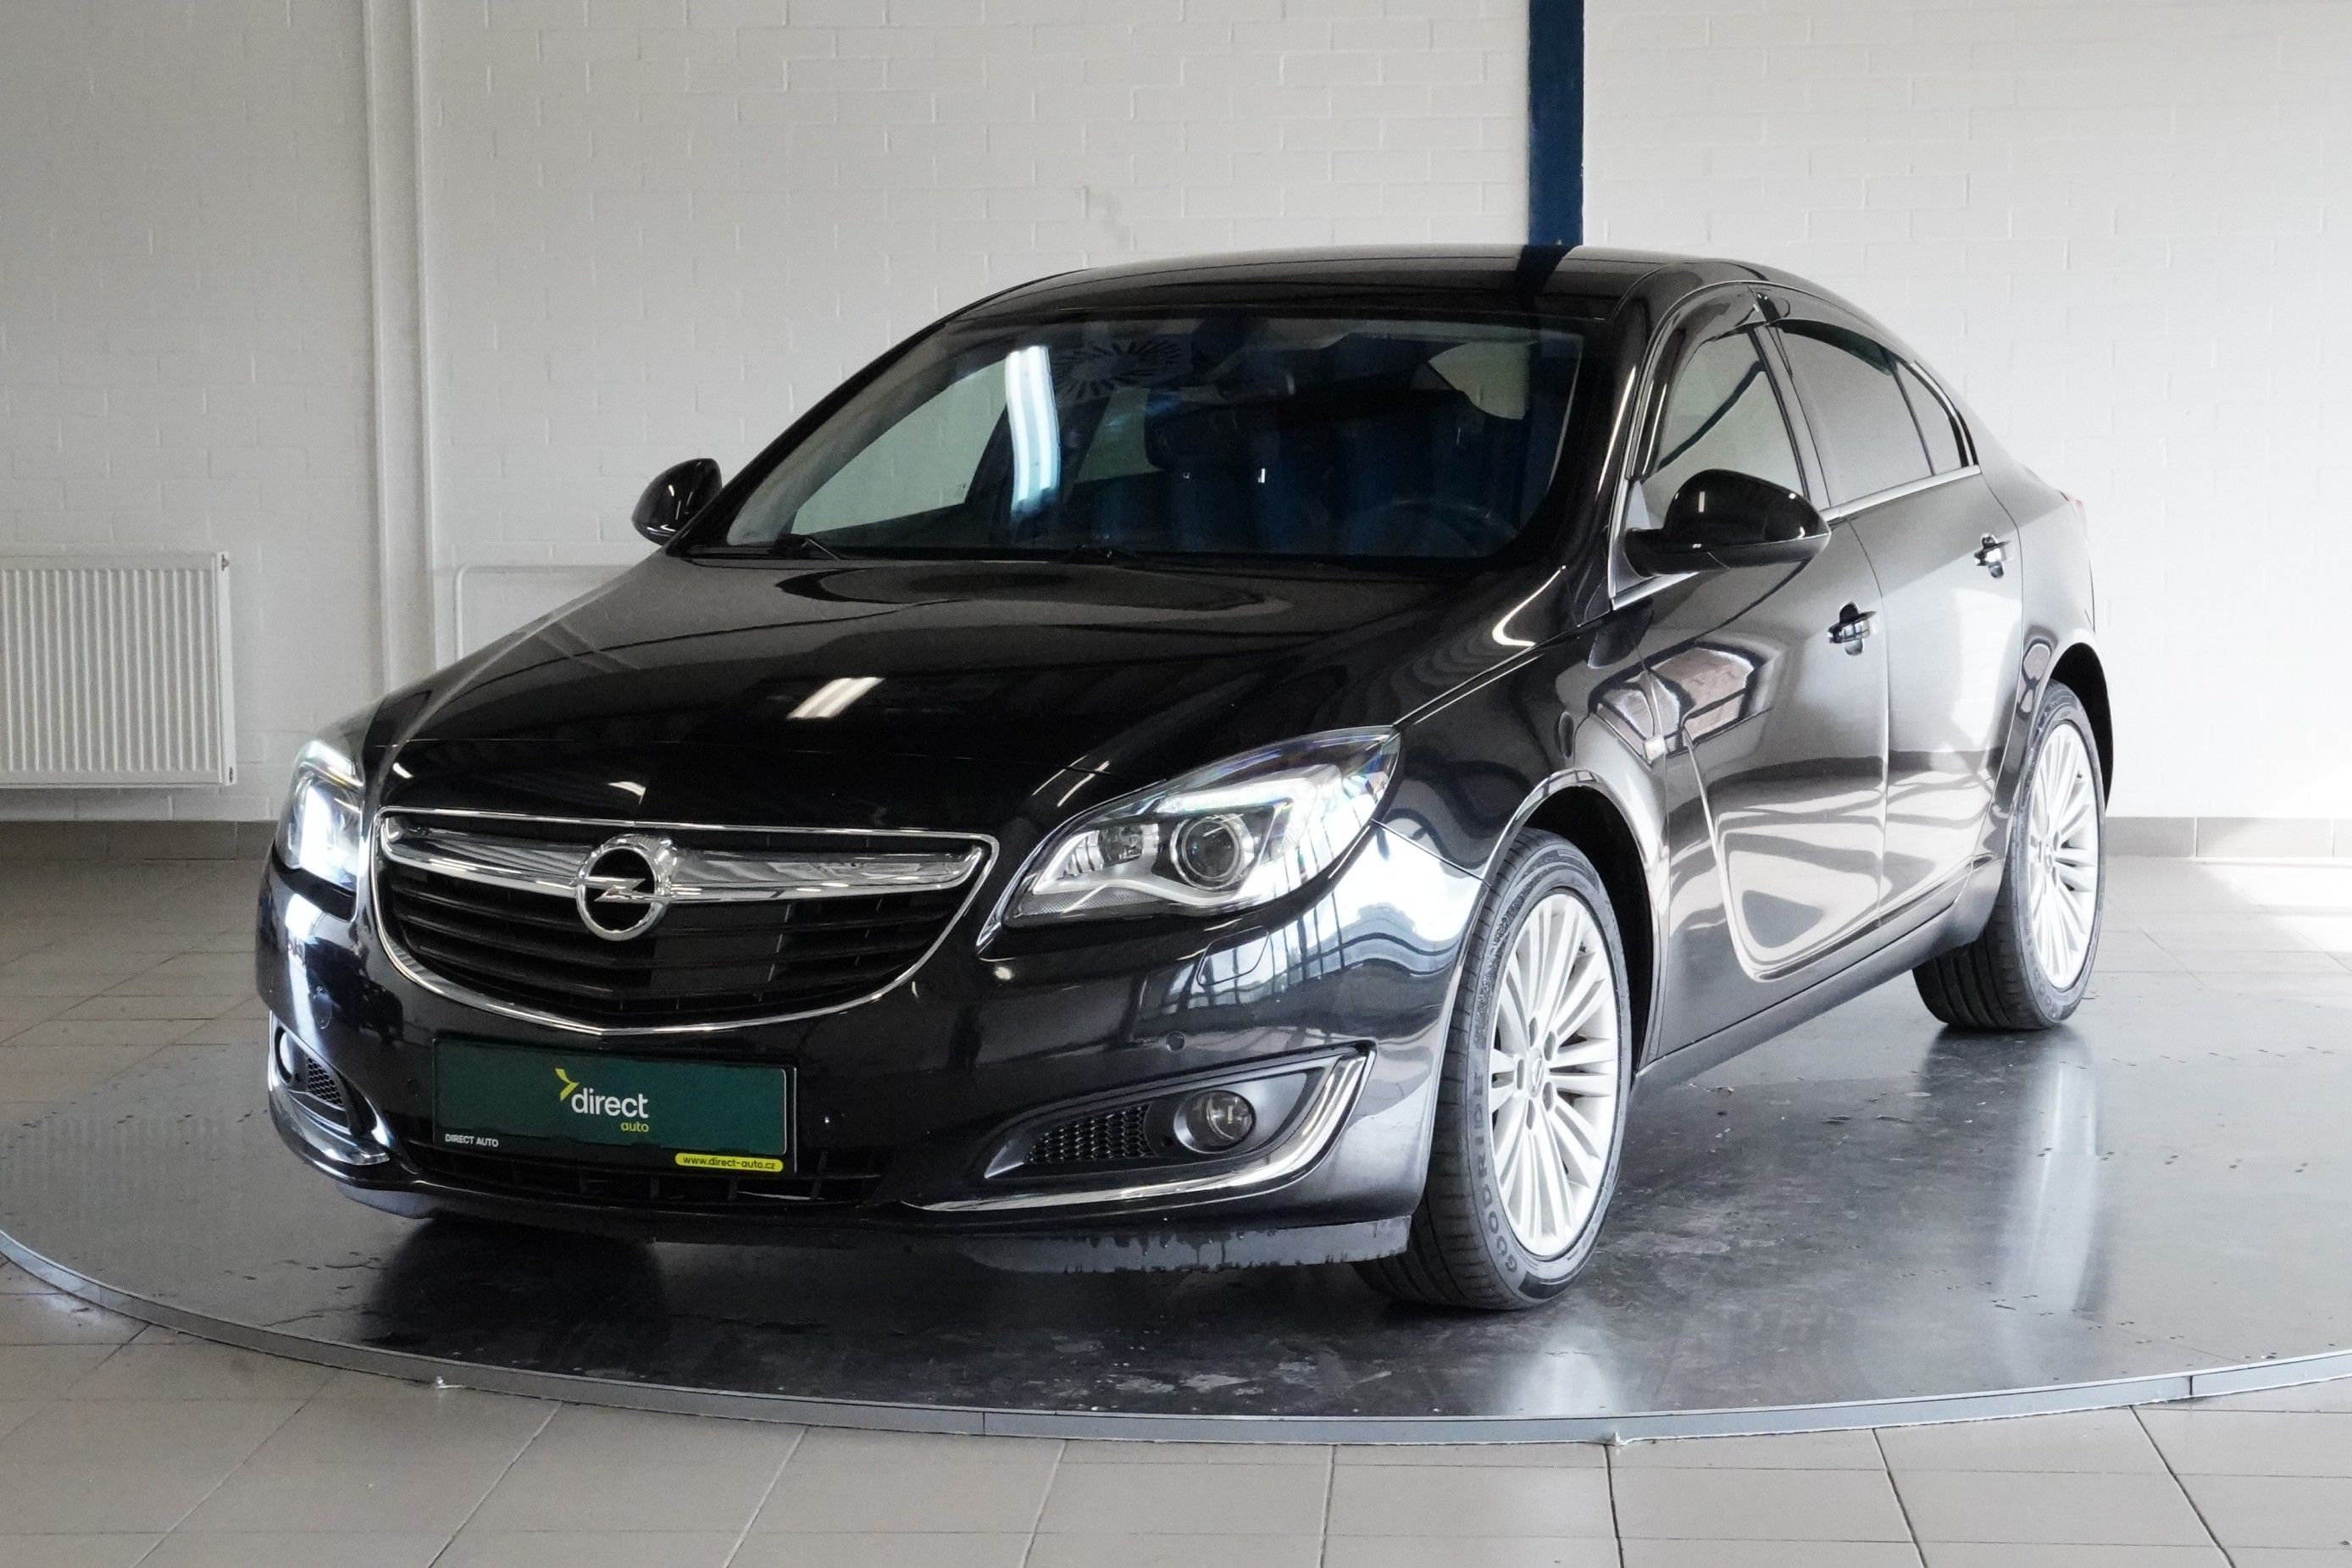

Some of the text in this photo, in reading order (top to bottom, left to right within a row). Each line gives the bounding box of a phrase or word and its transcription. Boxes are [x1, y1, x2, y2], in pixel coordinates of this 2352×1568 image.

[571, 1088, 649, 1118] direct
[620, 1122, 649, 1133] auto
[445, 1133, 499, 1147] DIRECT AUTO
[683, 1156, 775, 1170] www.direct-auto.cz
[1473, 1072, 1518, 1272] GOODRIDE
